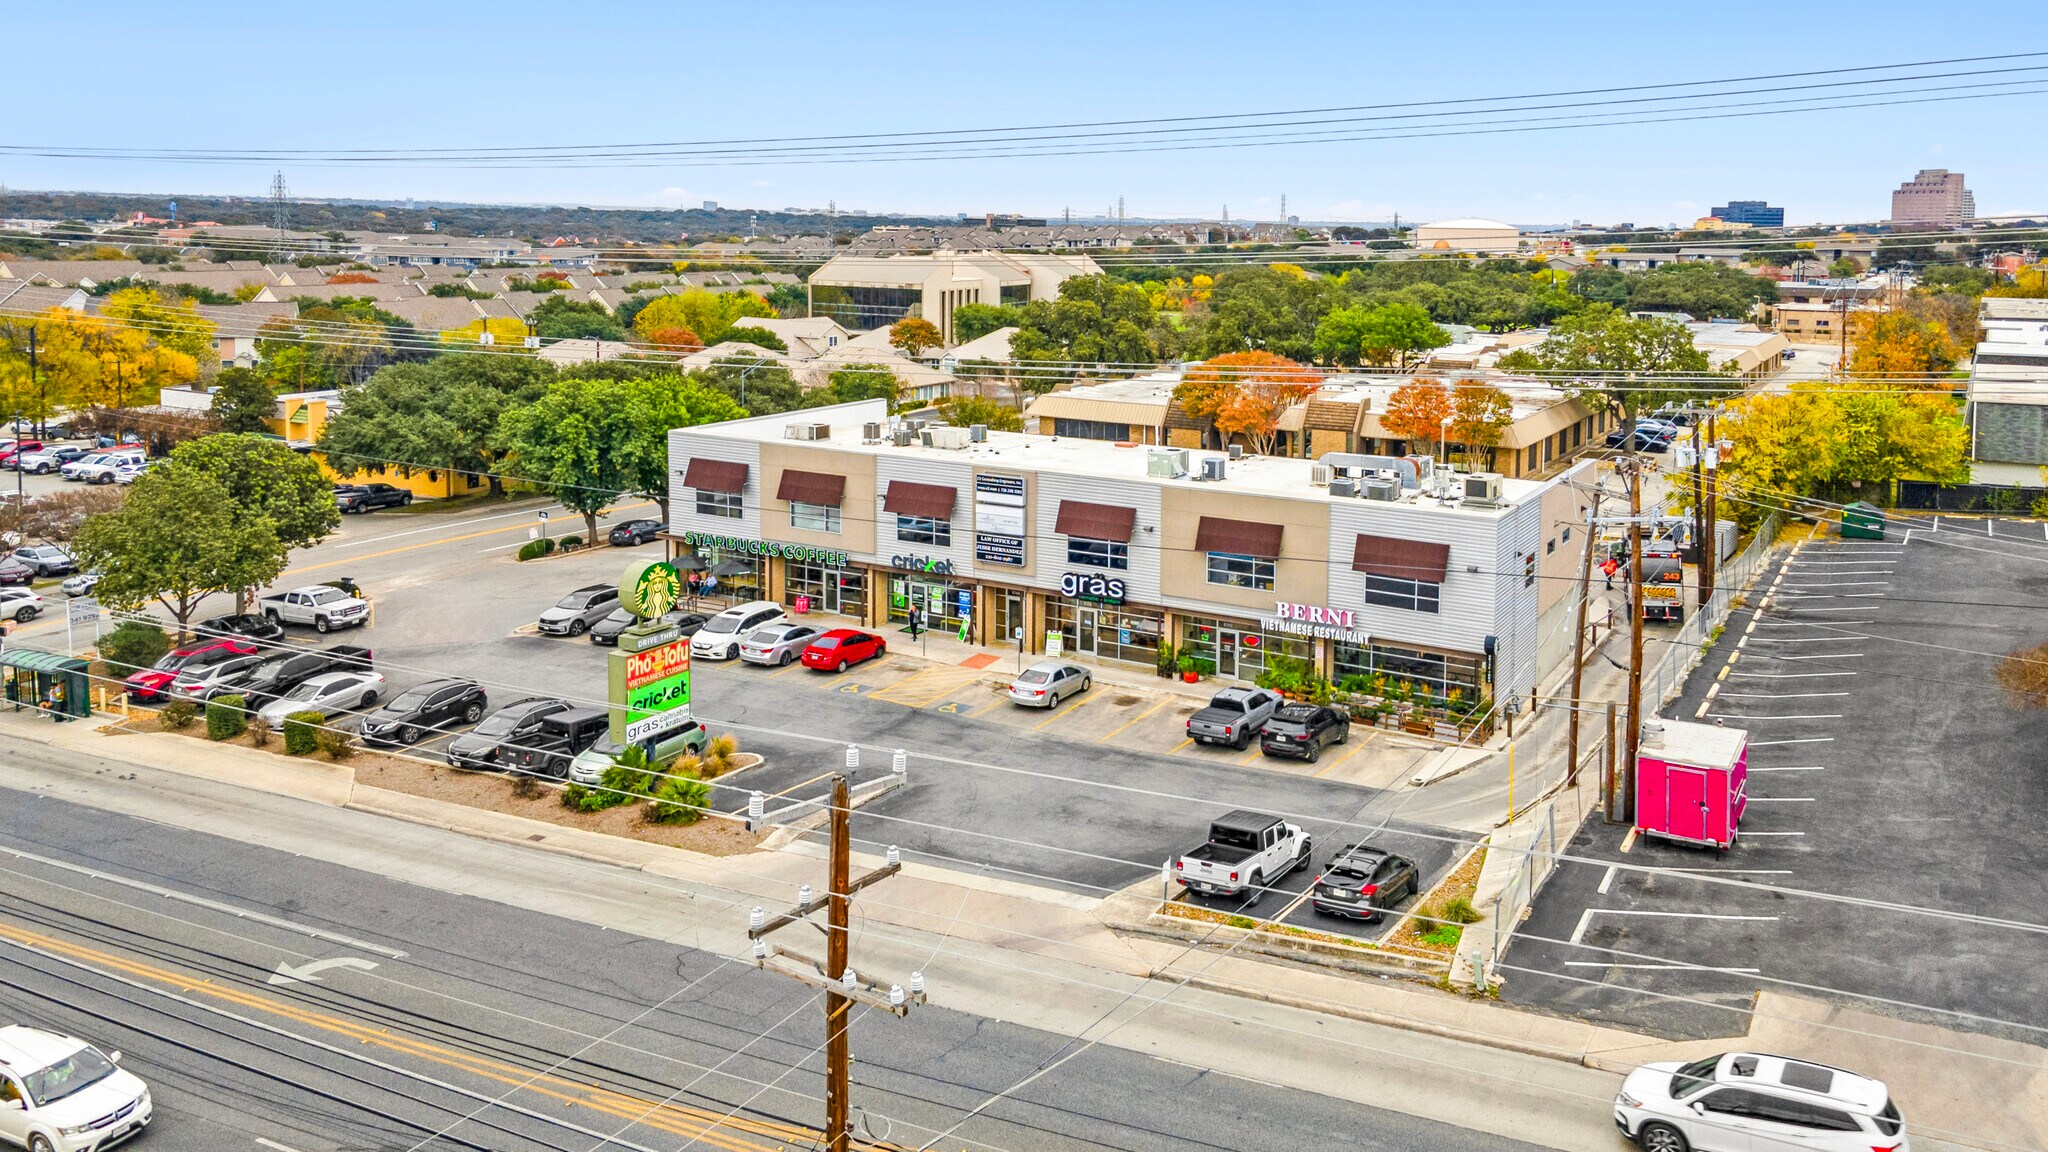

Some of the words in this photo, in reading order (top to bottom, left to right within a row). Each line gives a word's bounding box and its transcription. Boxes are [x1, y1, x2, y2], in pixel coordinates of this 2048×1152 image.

[684, 531, 779, 556] STARBUCKS
[783, 544, 847, 566] COFFEE
[992, 546, 1022, 555] HERNANDEZ
[891, 553, 954, 576] cricket
[1061, 573, 1124, 598] gräs
[1275, 601, 1356, 628] BERNI
[638, 636, 658, 648] DRIVE
[660, 630, 678, 640] THRU
[1260, 618, 1313, 636] VIETNAMESE
[1314, 626, 1372, 645] RESTAURANT
[664, 644, 688, 667] Tofu
[628, 670, 665, 688] VIETNAMESE
[666, 663, 688, 675] CUISINE
[633, 680, 687, 711] cricket
[628, 720, 659, 741] gräs
[660, 707, 689, 723] cannabis
[665, 715, 689, 729] kratom
